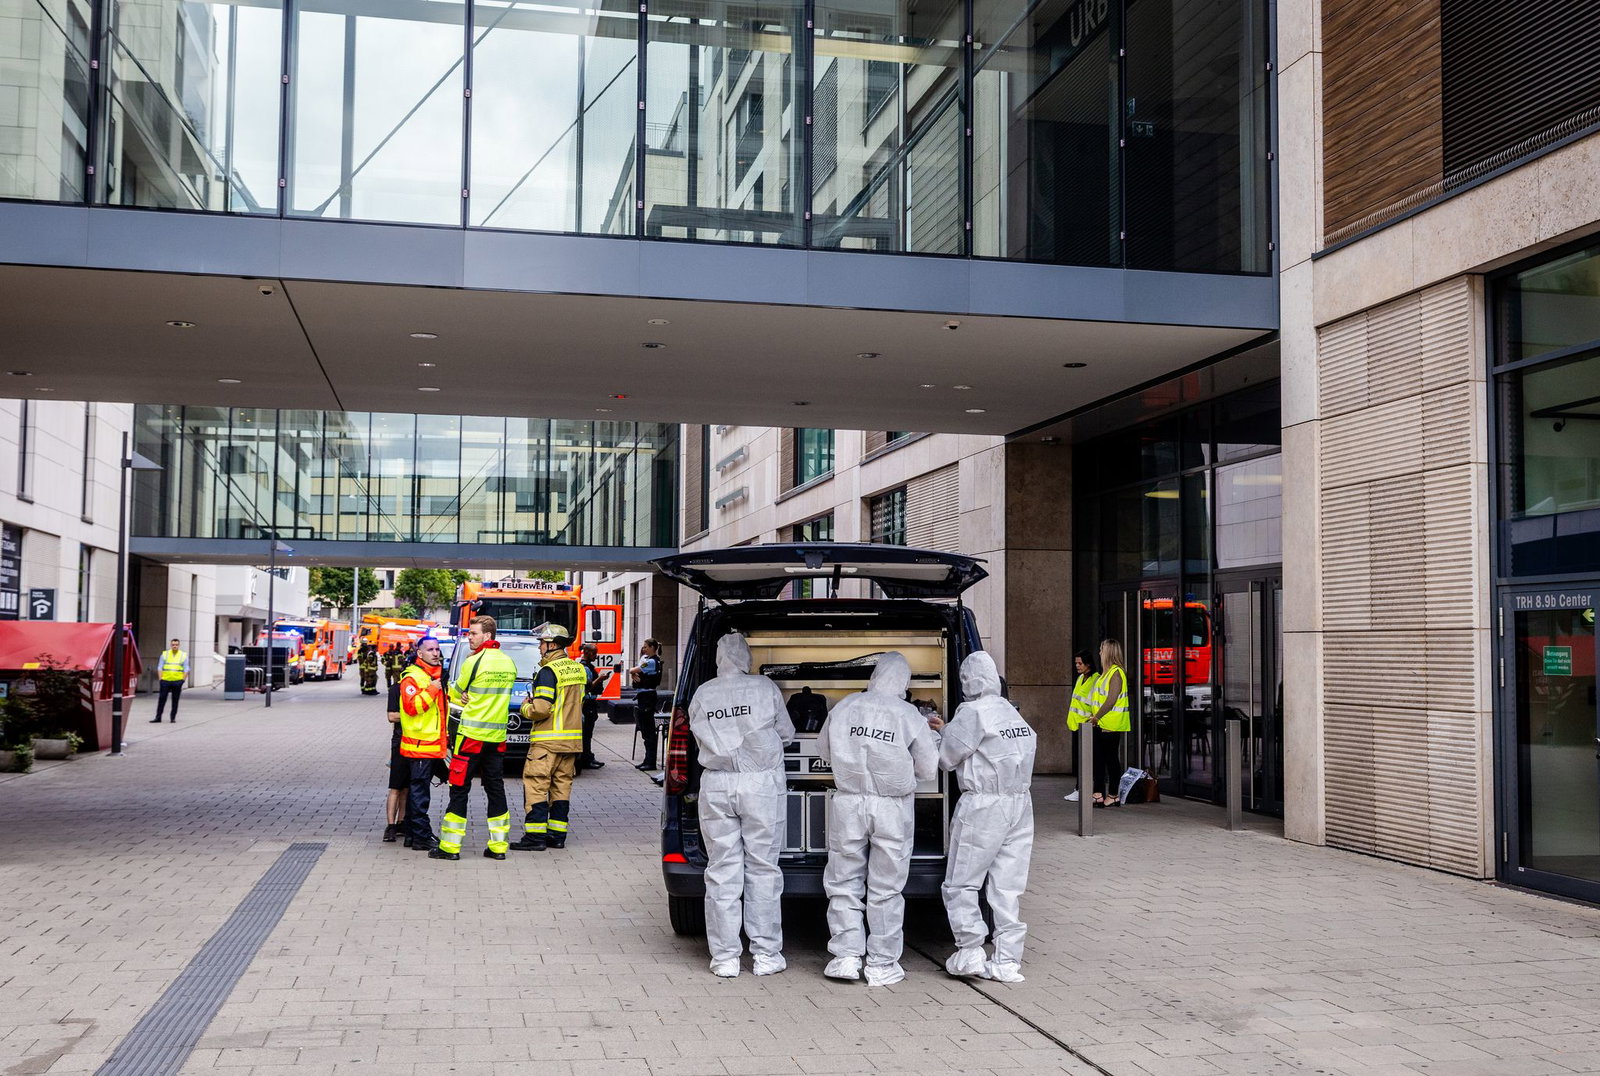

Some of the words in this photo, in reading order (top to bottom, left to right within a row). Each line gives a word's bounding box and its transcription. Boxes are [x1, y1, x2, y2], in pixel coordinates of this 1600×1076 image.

[502, 582, 553, 590] FEUERWEHR
[1516, 595, 1533, 609] TRH
[1535, 594, 1556, 608] 8.9b
[1559, 593, 1592, 607] Center
[36, 604, 48, 618] P
[596, 655, 613, 667] 112
[707, 705, 752, 721] POLIZEI
[849, 726, 895, 743] POLIZEI
